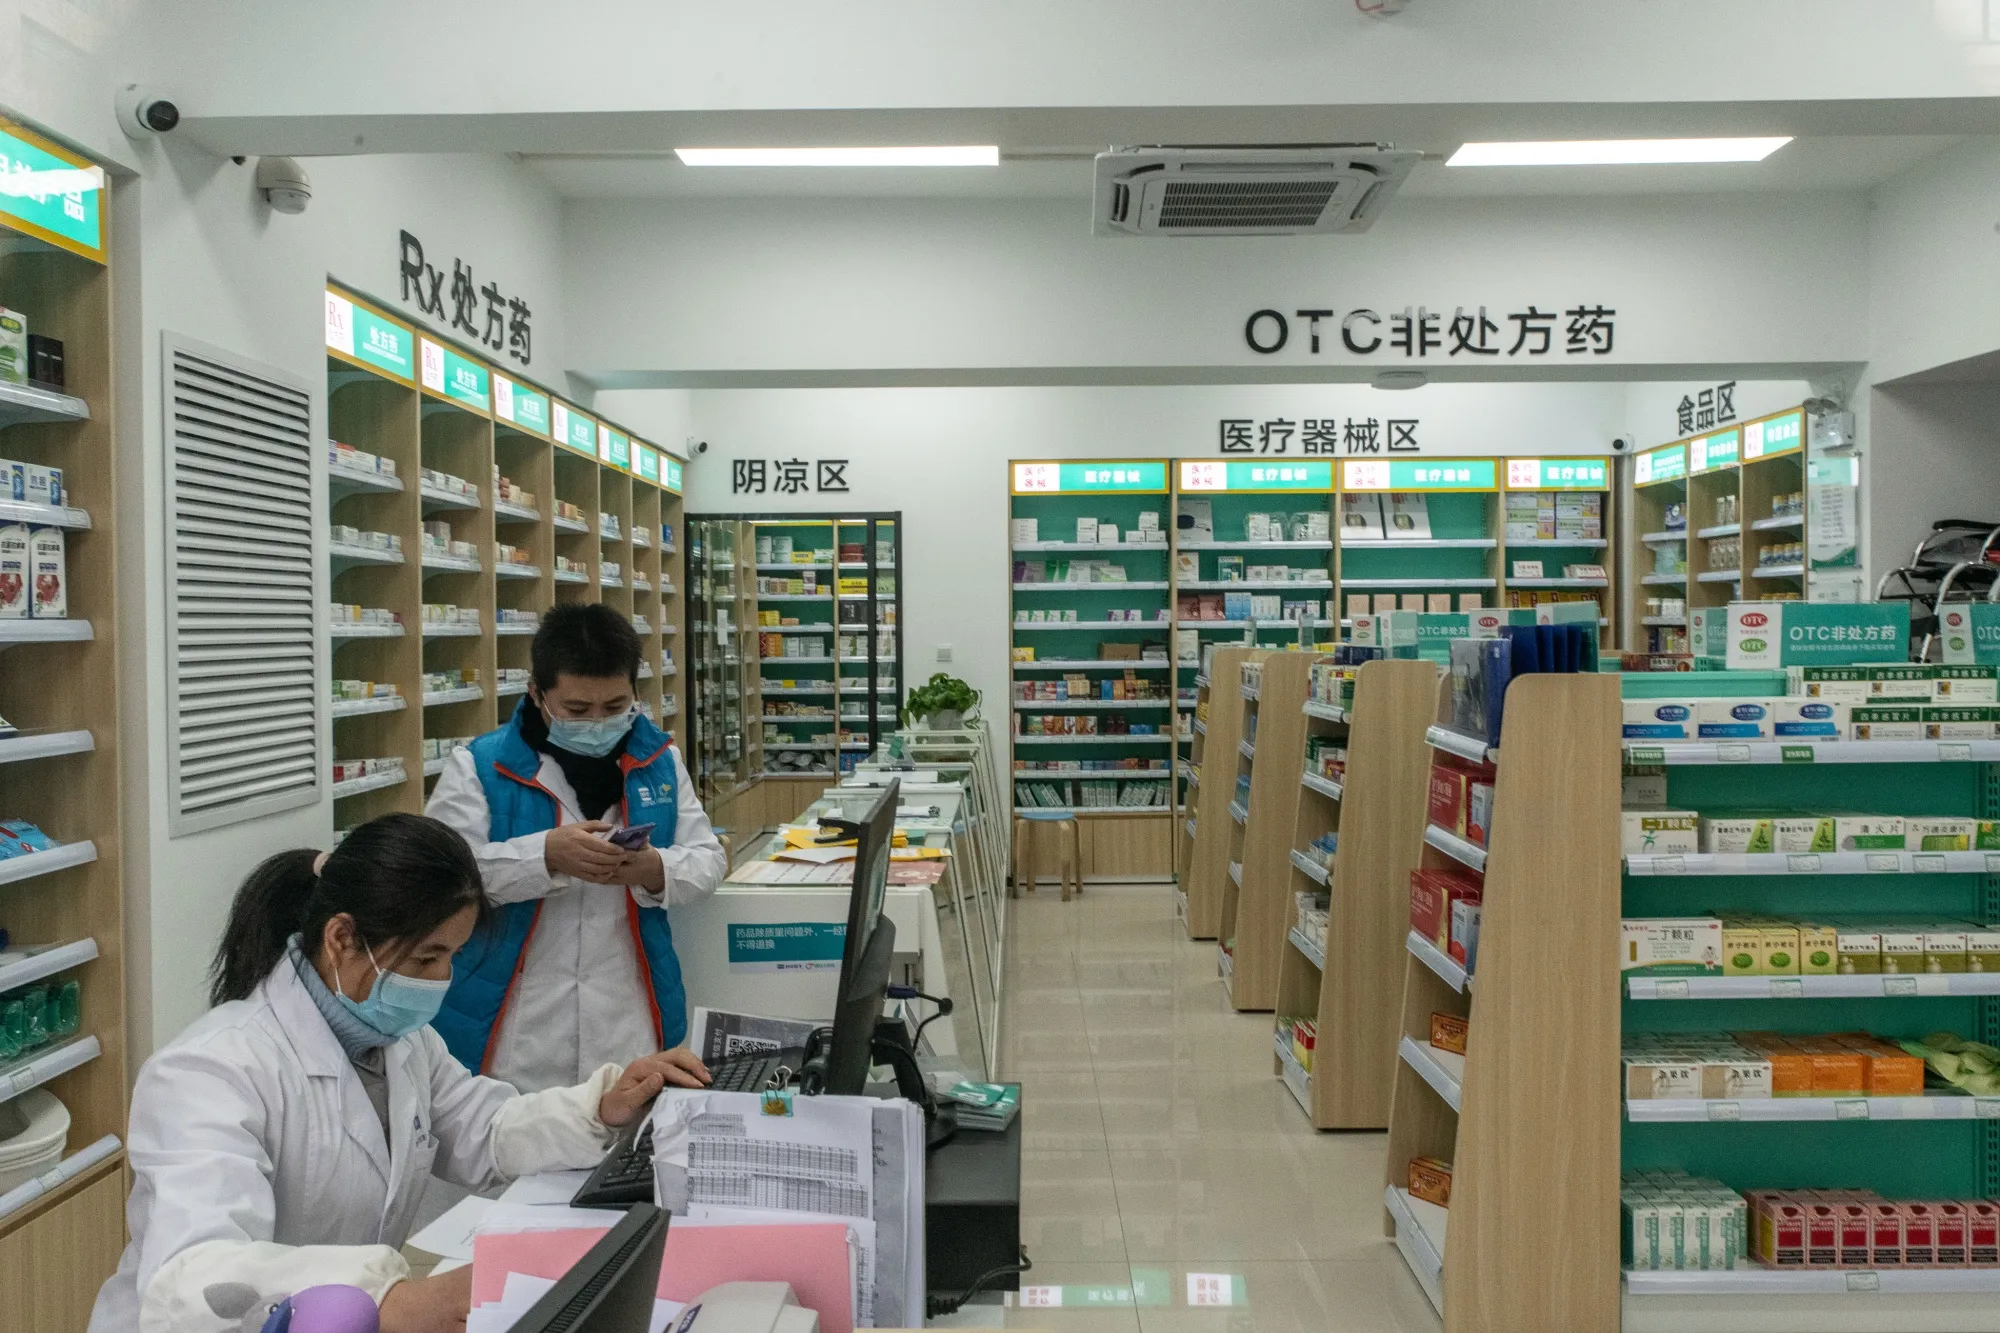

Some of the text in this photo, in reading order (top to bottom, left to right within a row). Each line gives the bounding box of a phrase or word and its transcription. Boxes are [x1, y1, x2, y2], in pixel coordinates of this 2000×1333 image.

[400, 228, 532, 365] Rx处方药
[328, 301, 344, 330] Rx
[1245, 305, 1616, 358] OTC非处方药
[1676, 381, 1737, 436] 食品区
[1219, 417, 1421, 454] 医疗器械区
[732, 458, 850, 493] 阴凉区
[1740, 614, 1767, 625] OTC
[1790, 626, 1896, 642] OTC非处方药
[1740, 640, 1767, 651] OTC
[1811, 671, 1859, 680] 四季感冒片
[1876, 671, 1924, 680] 四季感冒片
[1941, 669, 1988, 679] 四季感冒片
[1860, 712, 1911, 721] 四季感冒片
[1930, 711, 1980, 721] 四季感冒片
[1859, 824, 1899, 834] 清火片
[1647, 929, 1695, 941] 二丁颗粒
[736, 939, 776, 950] 不得退换
